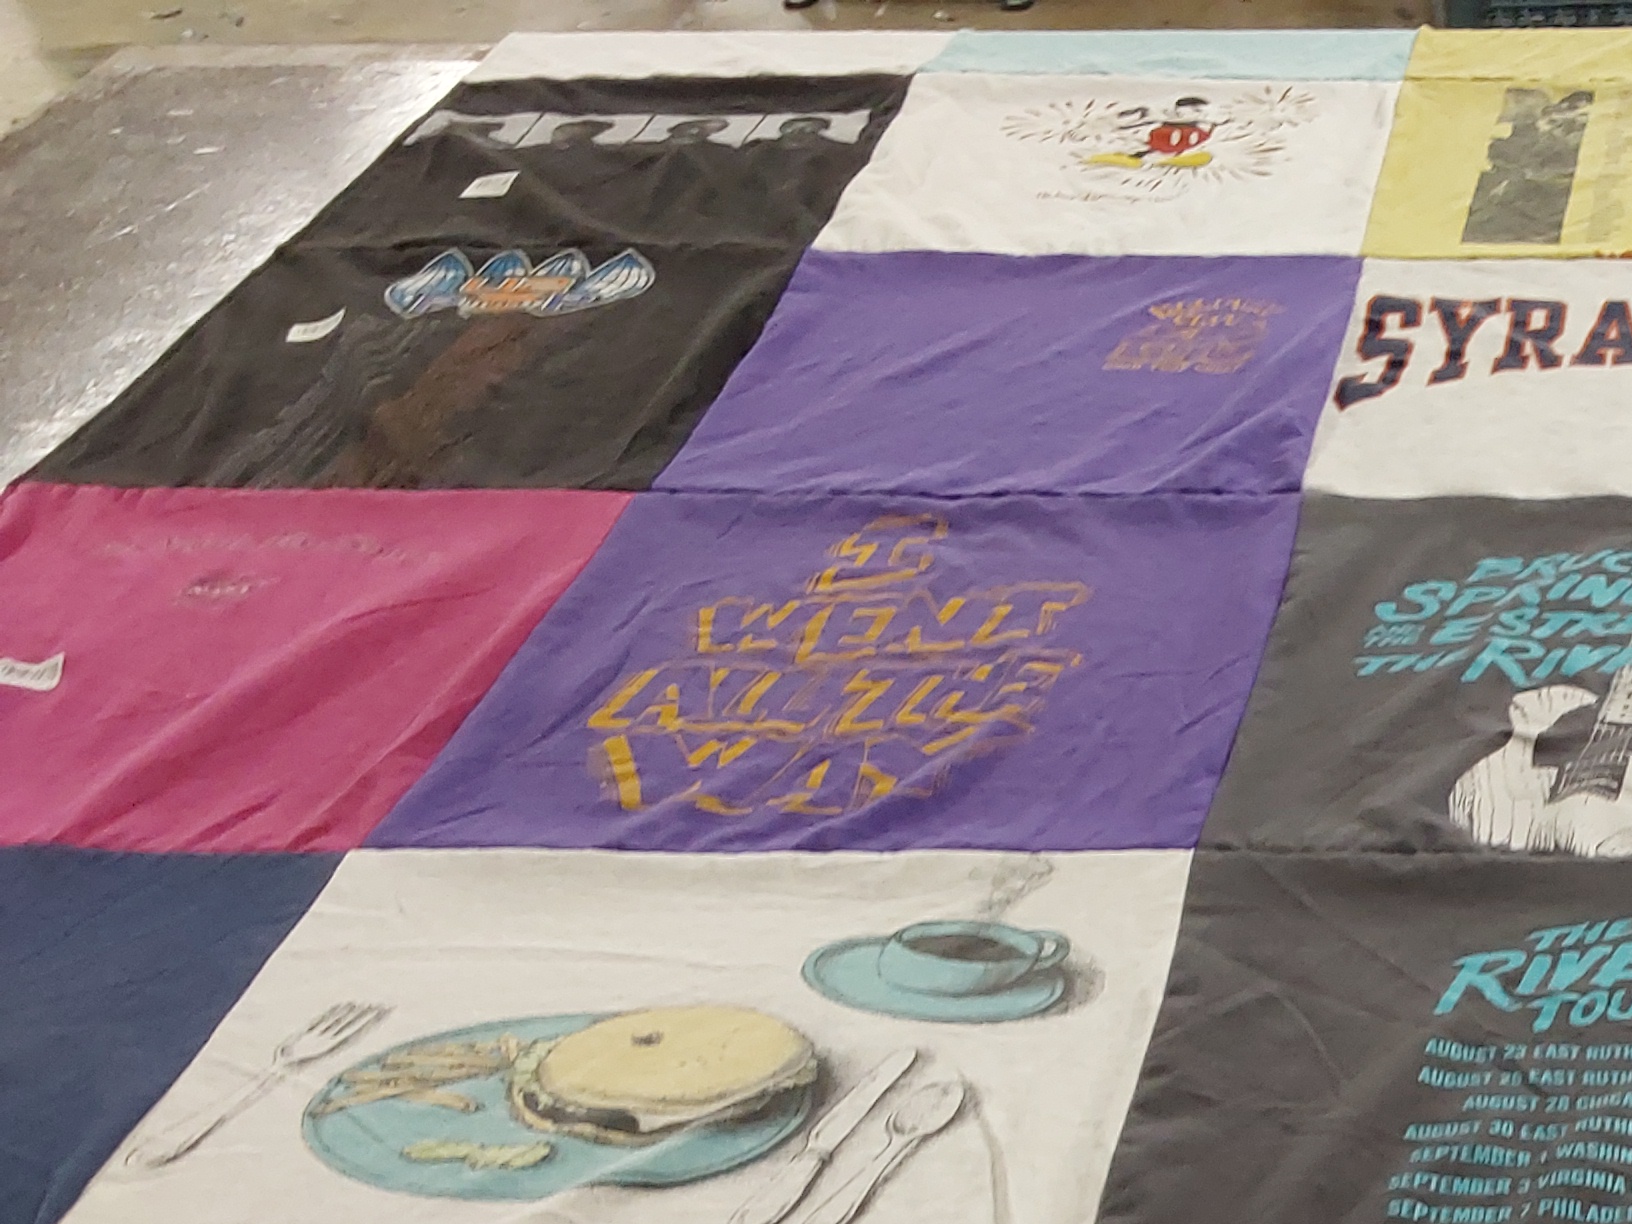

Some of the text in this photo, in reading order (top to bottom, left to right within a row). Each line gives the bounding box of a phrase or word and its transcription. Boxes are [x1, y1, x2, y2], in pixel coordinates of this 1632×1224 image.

[1424, 1038, 1496, 1064] AUGUST
[1533, 1045, 1580, 1061] EAST
[1417, 1066, 1492, 1088] AUGUST
[1528, 1069, 1575, 1086] EAST
[1462, 1095, 1538, 1112] AUGUST
[1403, 1120, 1481, 1140] AUGUST
[1489, 1119, 1514, 1138] 30
[1520, 1123, 1569, 1142] EAST
[1410, 1142, 1531, 1167] SEPTEMBER
[1388, 1171, 1512, 1195] SEPTEMBER
[1537, 1169, 1625, 1194] VIRGINIA
[1387, 1199, 1512, 1222] SEPTEMBER
